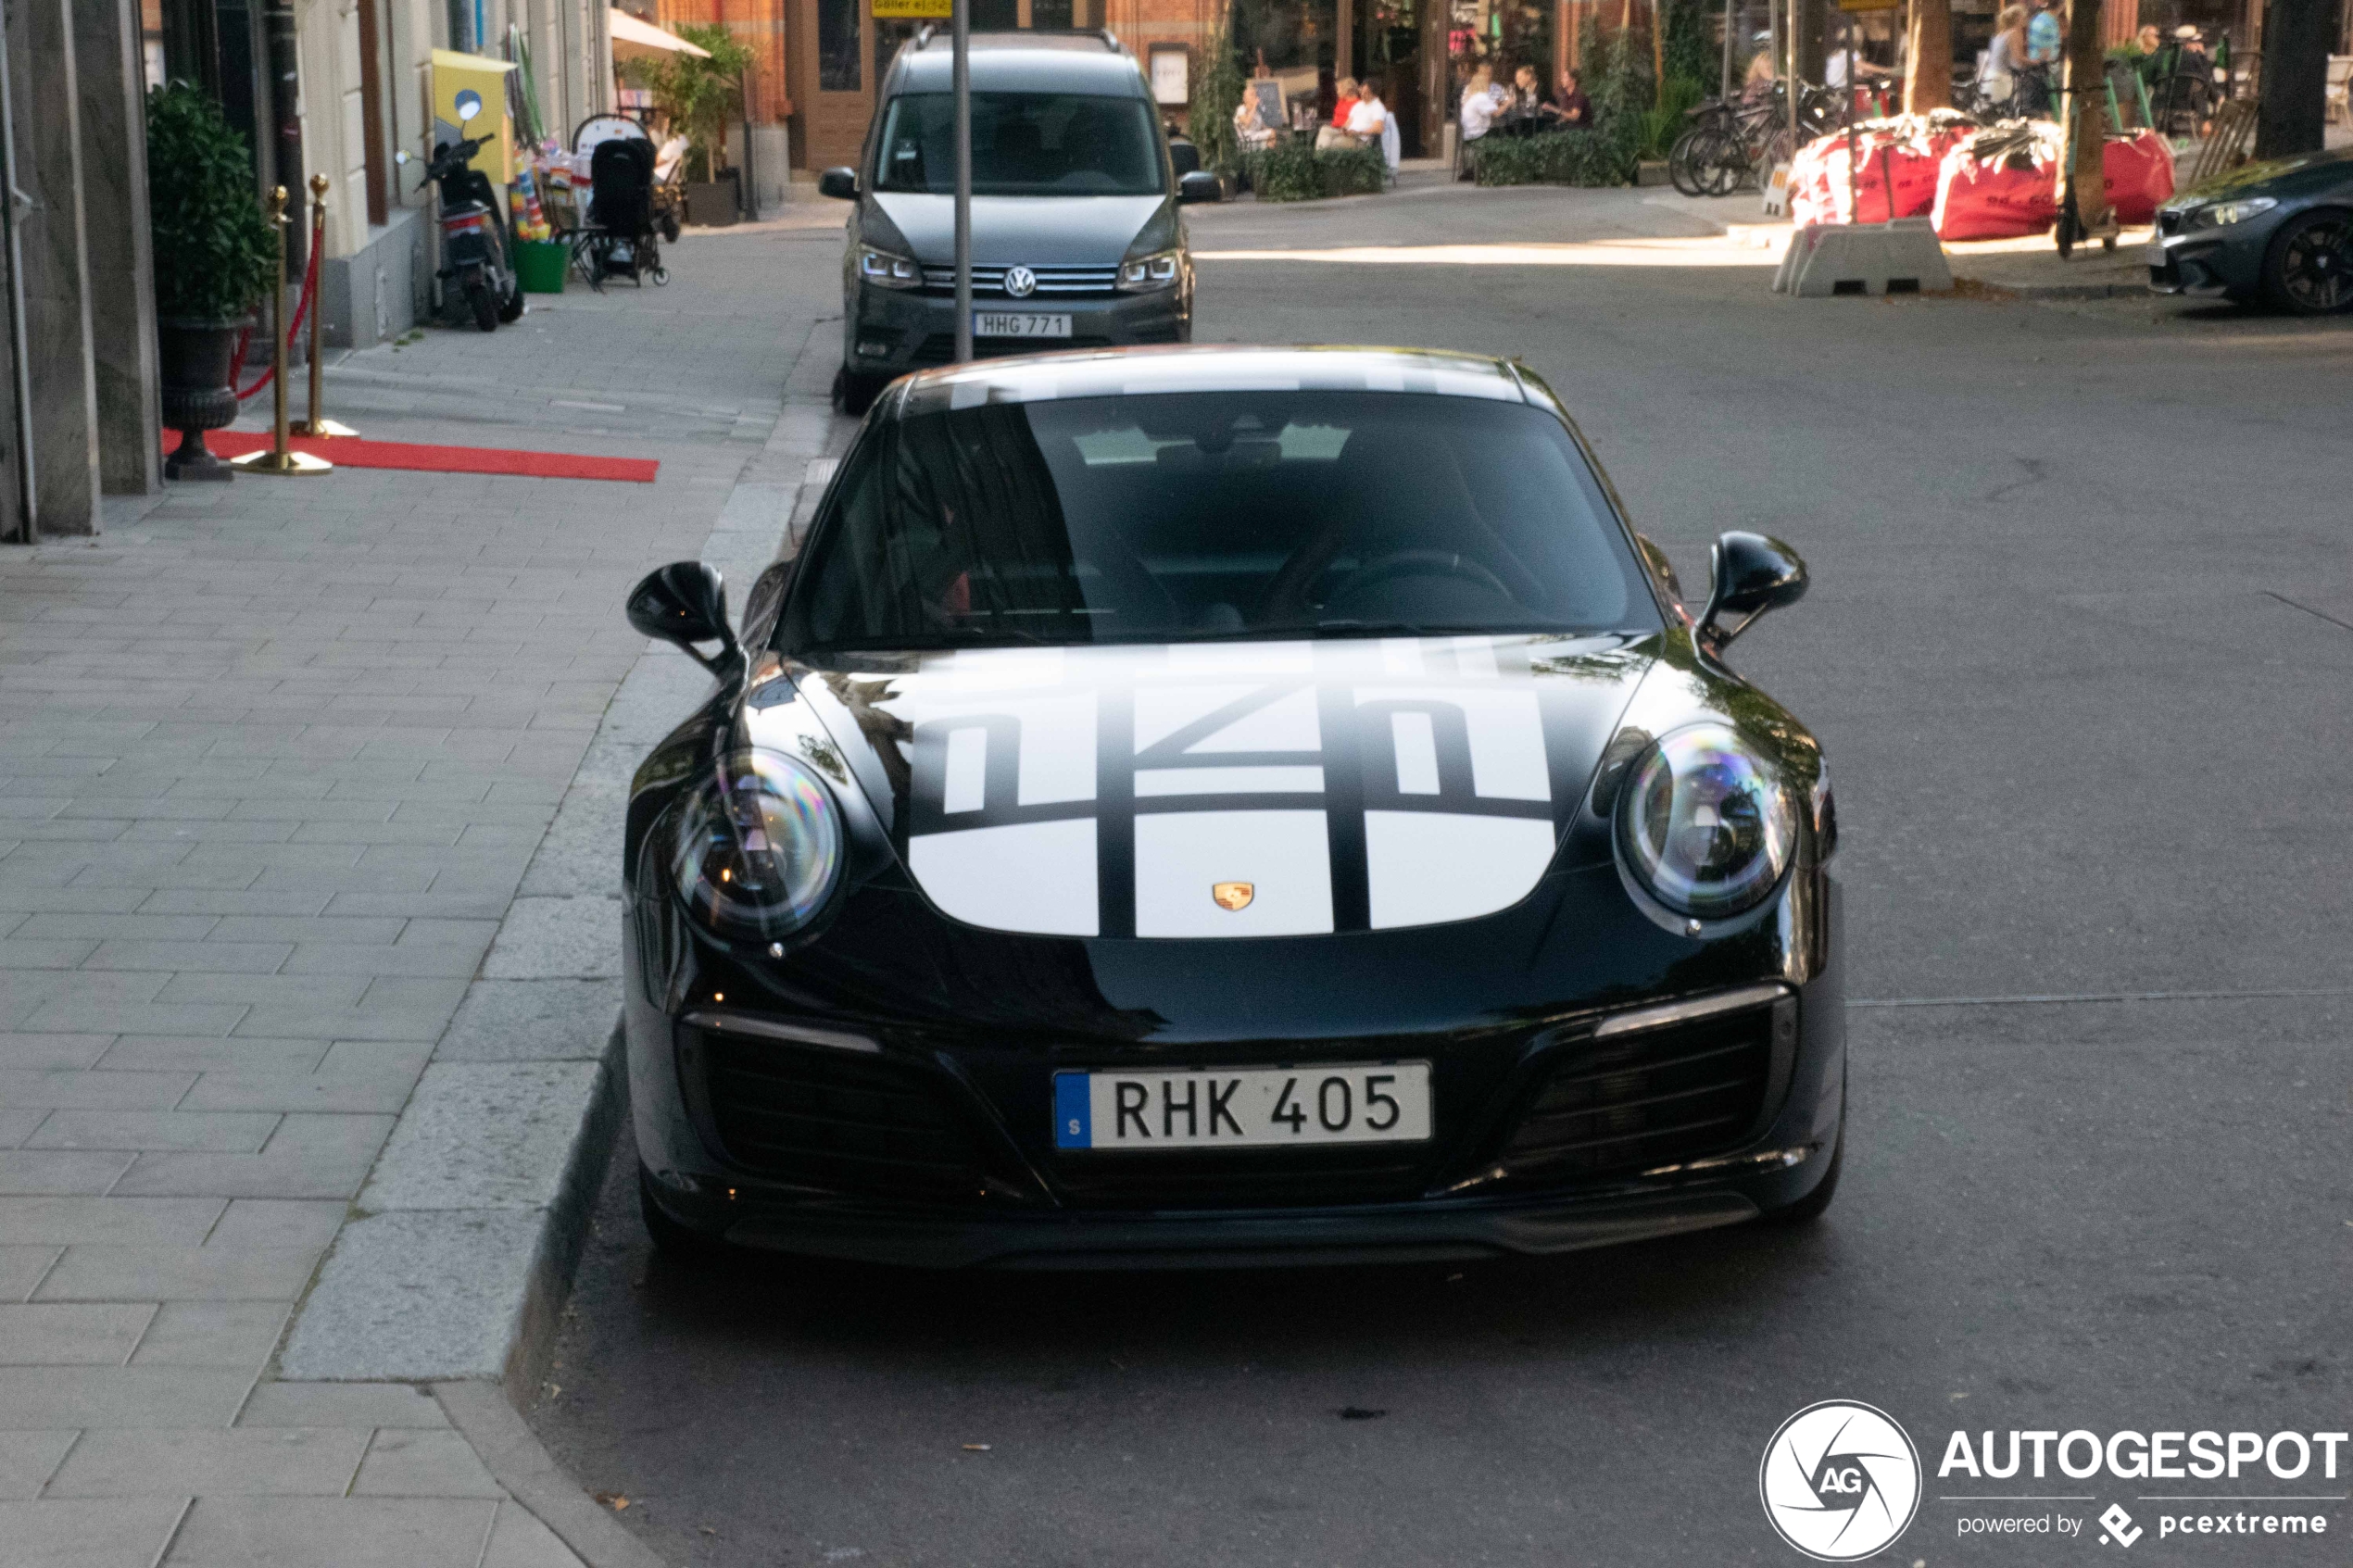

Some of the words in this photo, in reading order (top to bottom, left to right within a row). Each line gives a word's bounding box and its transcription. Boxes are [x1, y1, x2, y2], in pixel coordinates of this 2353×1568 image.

[984, 316, 1020, 333] HHG
[1026, 317, 1063, 334] 771
[1115, 1079, 1244, 1139] RHK
[1270, 1074, 1402, 1135] 405
